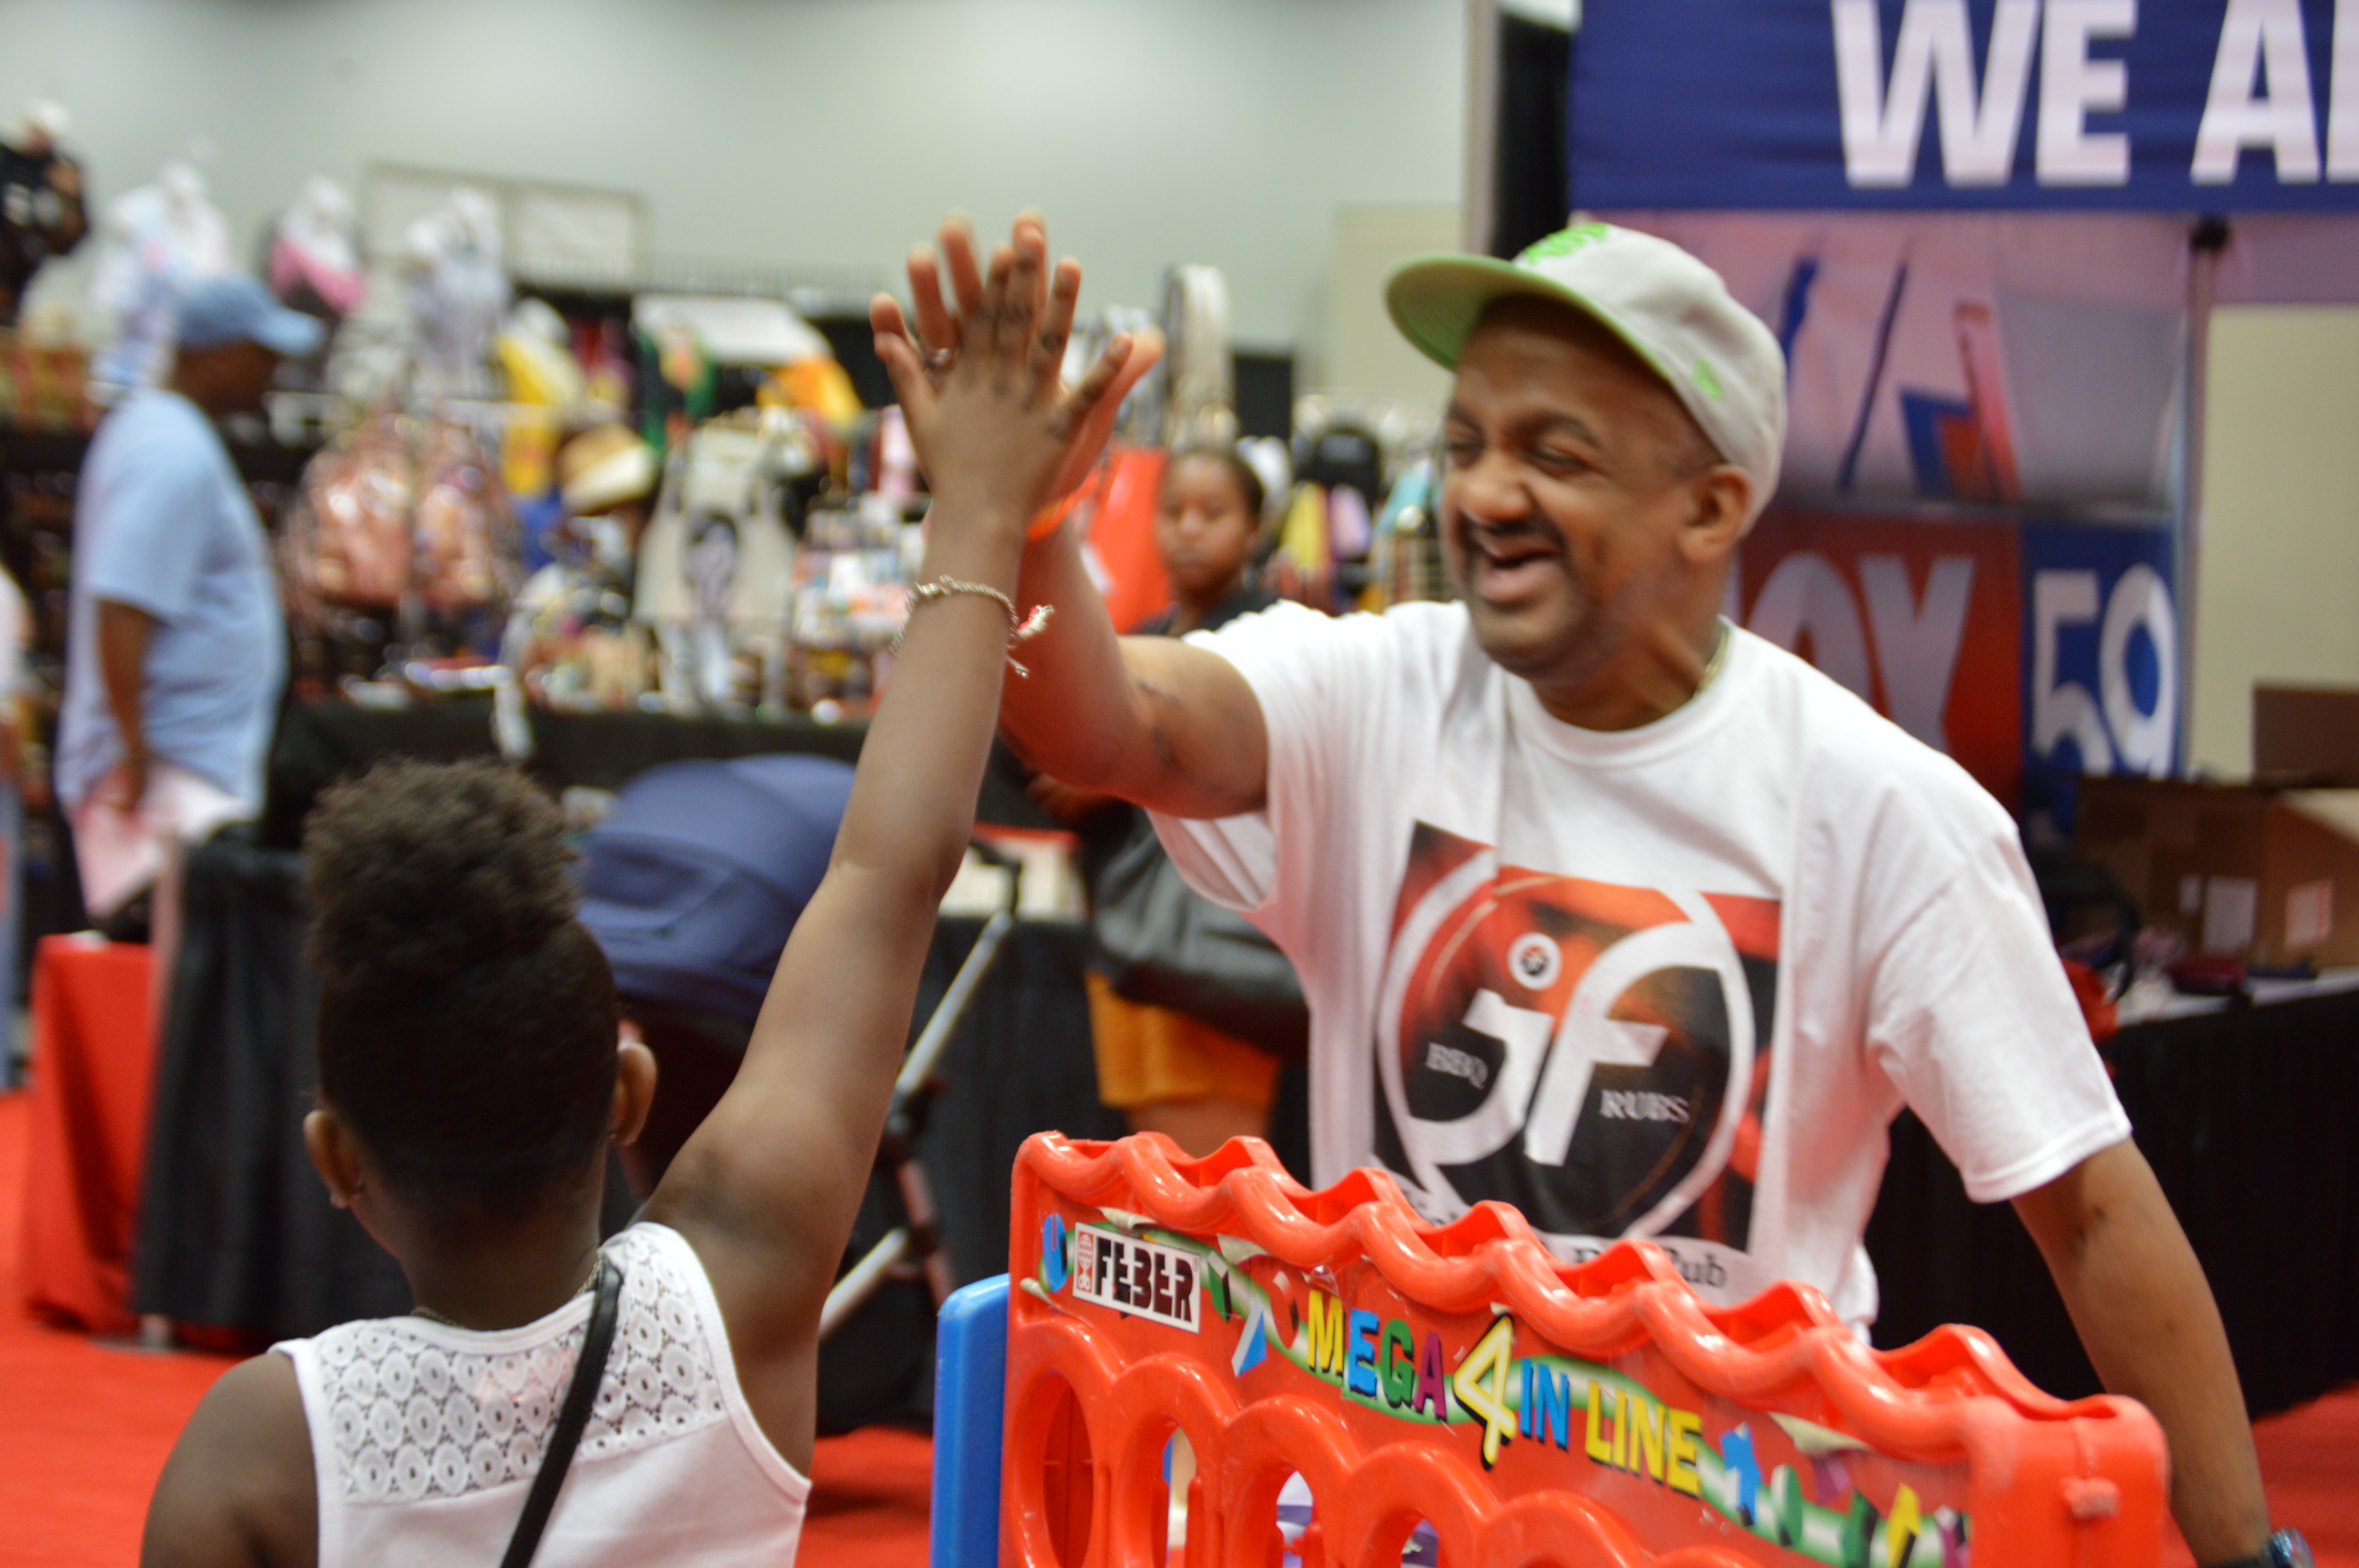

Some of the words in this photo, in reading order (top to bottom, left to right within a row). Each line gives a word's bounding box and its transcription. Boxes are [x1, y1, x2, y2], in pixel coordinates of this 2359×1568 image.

[1830, 0, 2138, 187] WE
[1425, 1042, 1488, 1090] BBQ
[1600, 1089, 1690, 1124] RUBS
[1095, 1235, 1193, 1323] FEBER
[1307, 1290, 1448, 1424] MEGA
[1452, 1312, 1517, 1470] 4
[1519, 1357, 1569, 1450] IN
[1584, 1378, 1703, 1497] LINE
